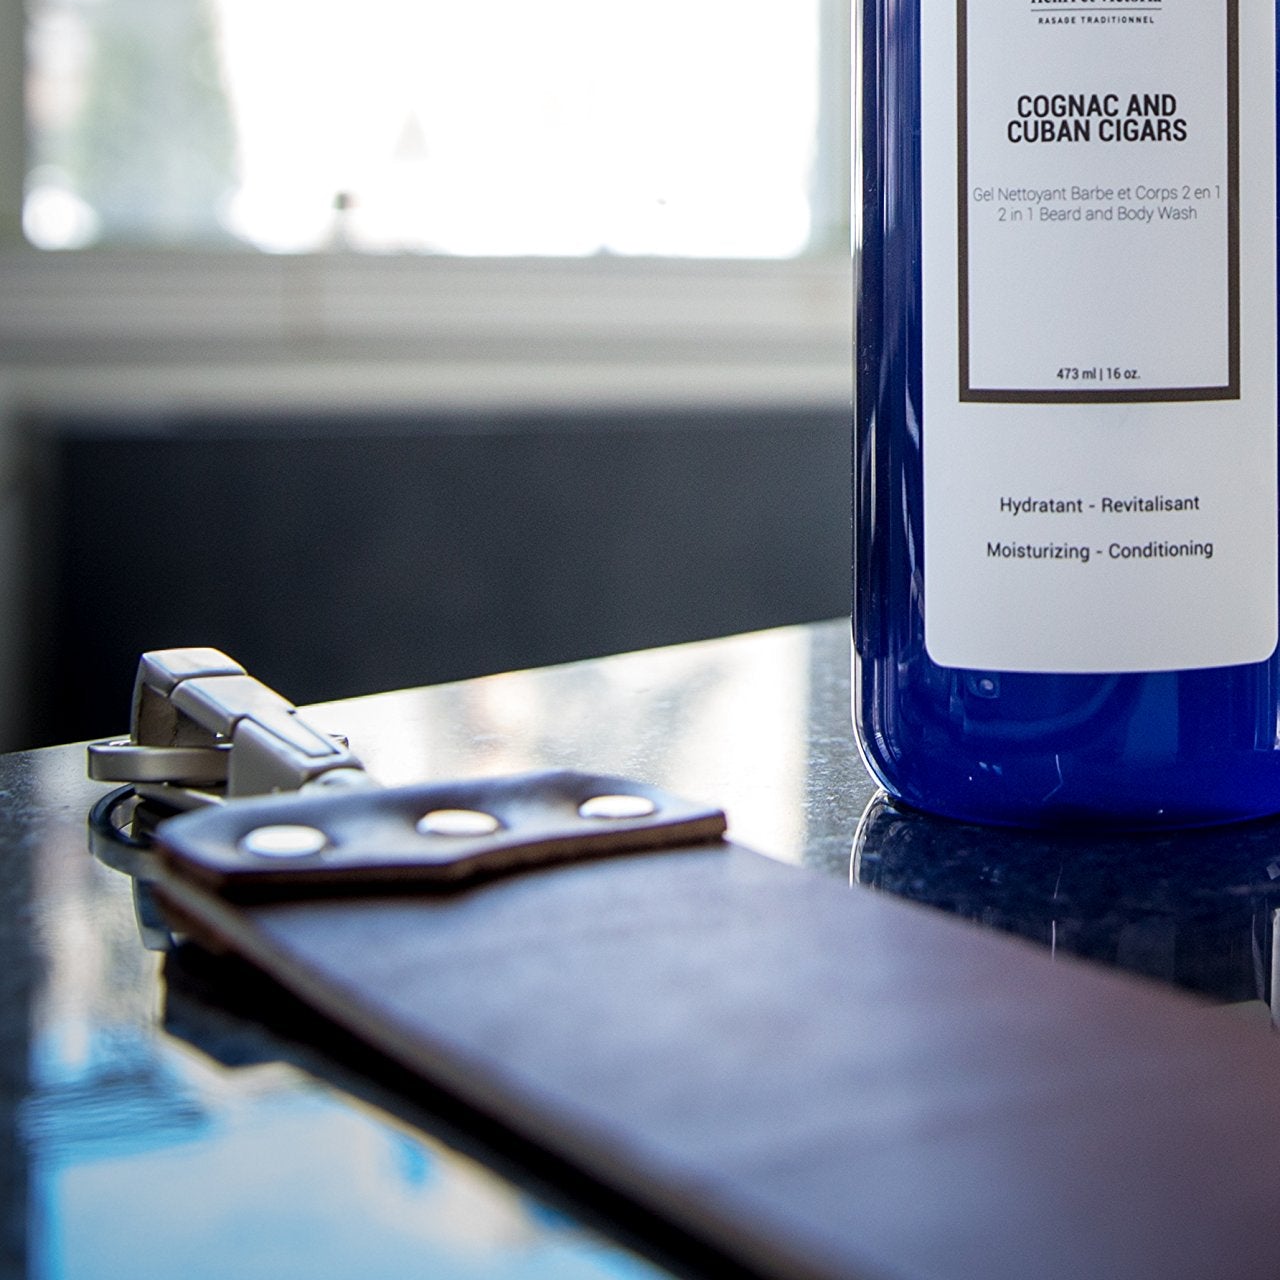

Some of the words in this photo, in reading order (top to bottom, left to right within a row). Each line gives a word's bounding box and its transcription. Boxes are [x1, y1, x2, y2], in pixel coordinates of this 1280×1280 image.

[1037, 16, 1077, 25] RASAGE
[1080, 15, 1155, 25] TRADITIONNEL
[1017, 94, 1119, 118] COGNAC
[1126, 93, 1177, 117] AND
[1007, 120, 1091, 143] CUBAN
[1098, 118, 1188, 142] CIGARS
[972, 186, 995, 202] Gel
[998, 187, 1067, 206] Nettoyant
[1070, 185, 1115, 202] Barbe
[1116, 186, 1132, 201] et
[1135, 184, 1178, 203] Corps
[1182, 185, 1191, 200] 2
[1194, 188, 1211, 200] en
[1214, 184, 1221, 200] 1
[997, 207, 1007, 222] 2
[1010, 207, 1023, 221] in
[1027, 207, 1034, 221] 1
[1039, 206, 1082, 221] Beard
[1084, 206, 1114, 221] and
[1117, 205, 1155, 224] Body
[1157, 205, 1198, 221] Wash
[1056, 367, 1080, 381] 473
[1081, 367, 1097, 380] ml
[1106, 367, 1122, 380] 16
[1123, 369, 1142, 380] oz.
[999, 496, 1084, 516] Hydratant
[1101, 495, 1200, 514] Revitalisant
[986, 541, 1091, 563] Moisturizing
[1108, 539, 1214, 560] Conditioning
